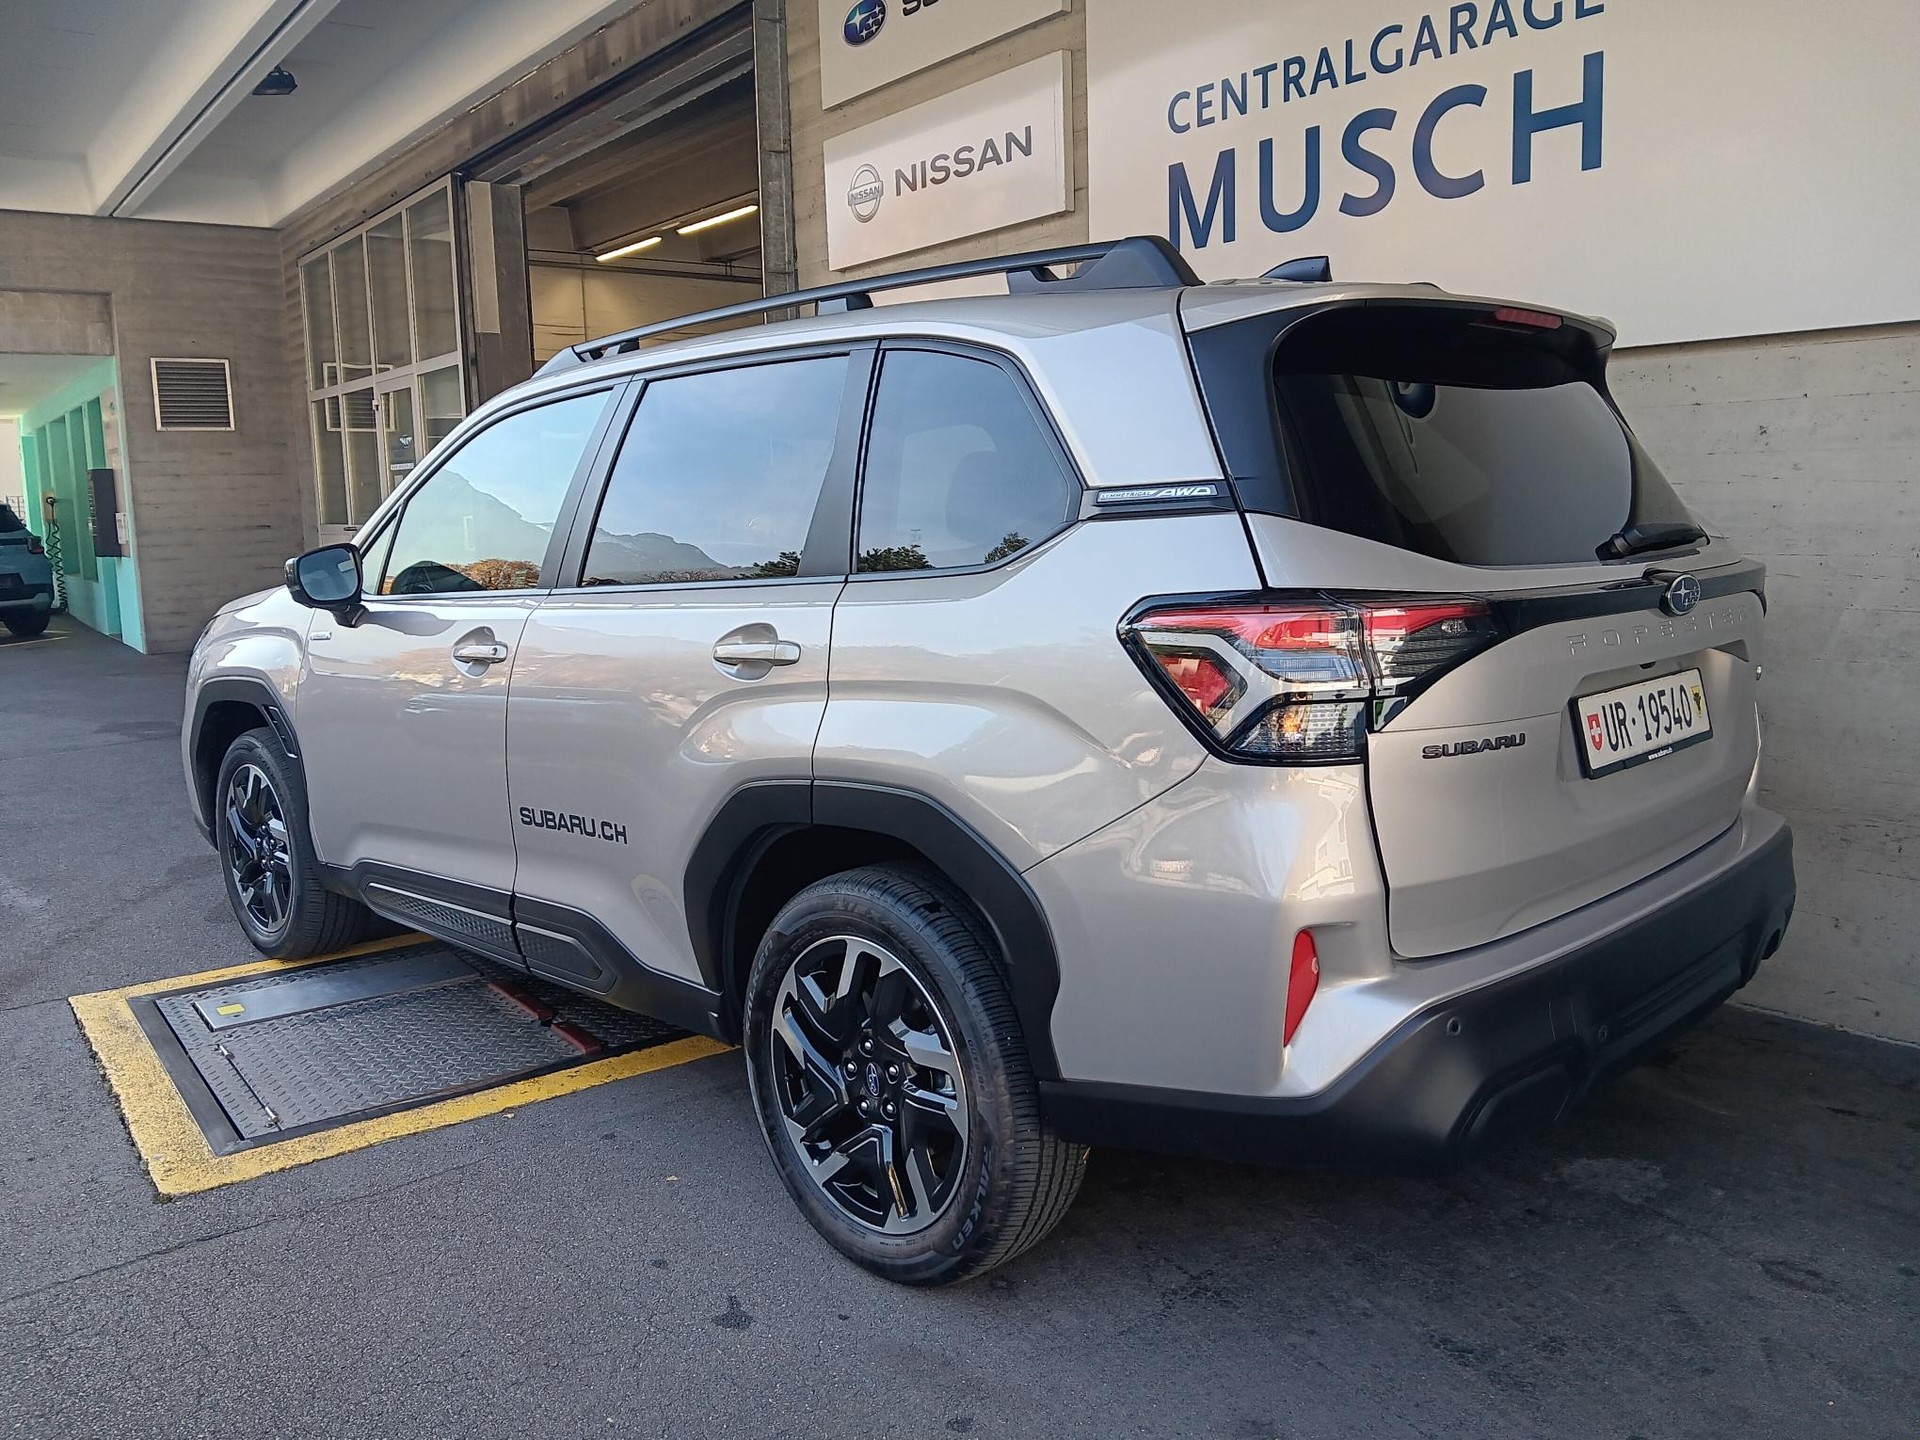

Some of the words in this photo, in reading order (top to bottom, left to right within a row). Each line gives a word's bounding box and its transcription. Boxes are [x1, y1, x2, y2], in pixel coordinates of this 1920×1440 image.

[894, 125, 1032, 197] NISSAN
[1168, 51, 1605, 252] MUSCH
[1155, 485, 1211, 498] AWD
[1422, 732, 1526, 760] SUBARU
[519, 806, 628, 845] SUBARU.CH
[952, 1145, 992, 1251] FALKEN
